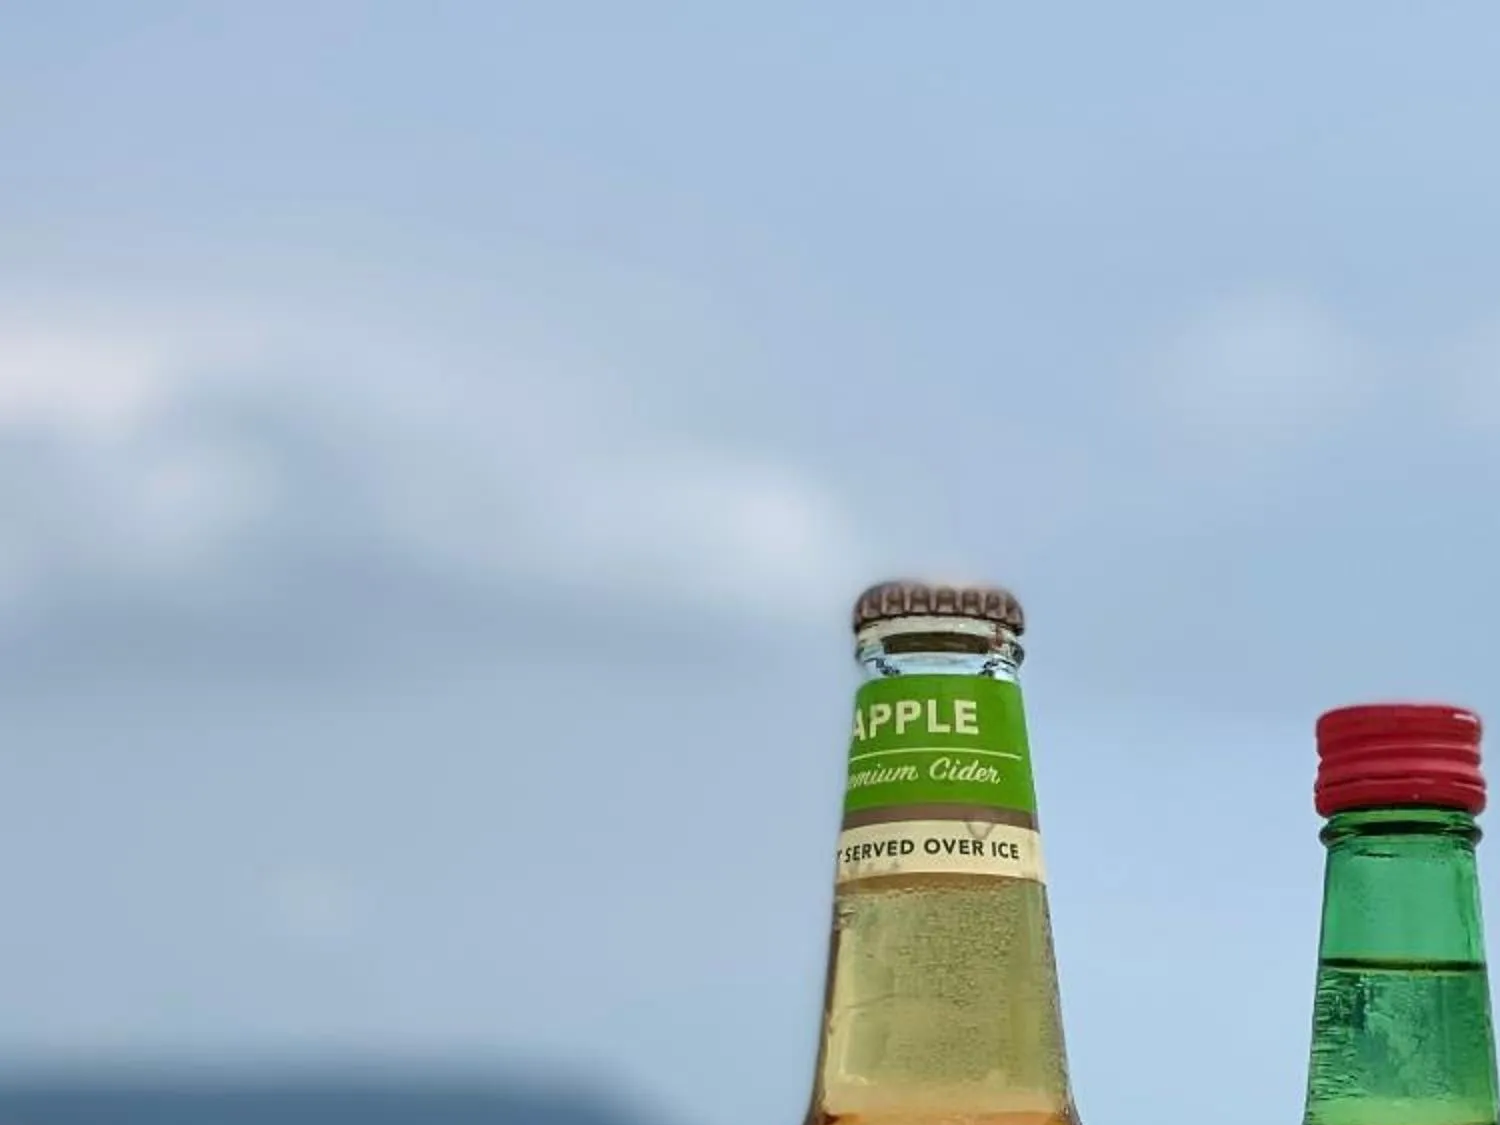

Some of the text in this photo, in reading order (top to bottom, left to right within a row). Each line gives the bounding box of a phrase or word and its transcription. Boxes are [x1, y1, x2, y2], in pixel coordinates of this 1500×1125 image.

[854, 699, 979, 741] APPLE
[929, 757, 1001, 784] Cider
[844, 839, 915, 863] SERVED
[924, 837, 984, 857] OVER
[992, 841, 1020, 860] ICE
